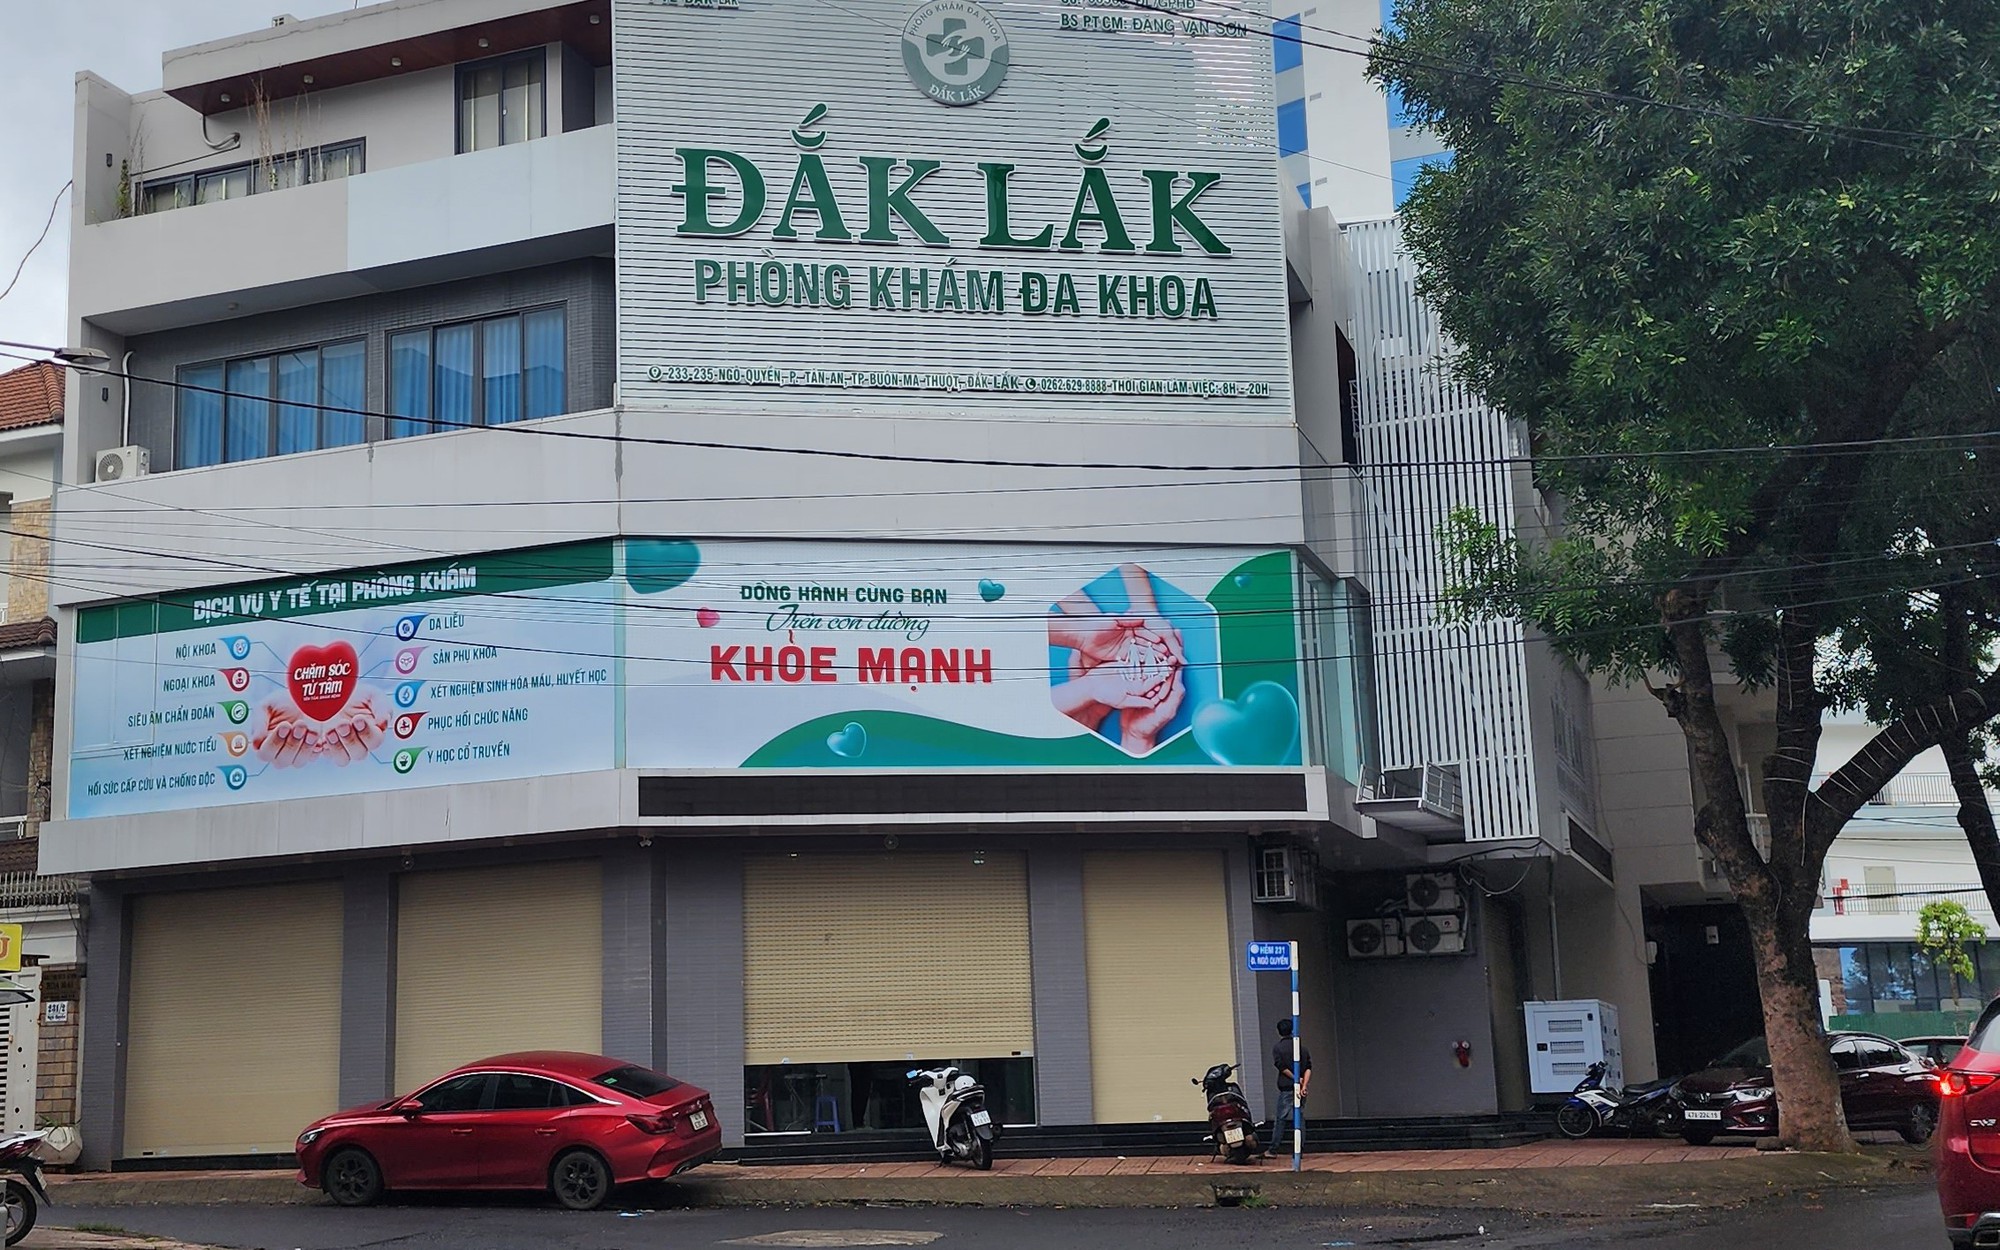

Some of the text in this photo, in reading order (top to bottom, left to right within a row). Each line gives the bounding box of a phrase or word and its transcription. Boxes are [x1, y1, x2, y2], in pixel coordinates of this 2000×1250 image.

[981, 16, 1001, 41] KHOA
[1061, 13, 1078, 27] BS
[670, 103, 1233, 256] ĐẮK LẮK
[694, 248, 1218, 319] PHÒNG KHÁM ĐA KHOA
[903, 374, 920, 387] MA
[1139, 380, 1163, 393] GIAN
[1222, 382, 1236, 395] 8H
[1248, 382, 1268, 395] 20H
[193, 562, 477, 623] DỊCH VỤ Y TẾ TẠI PHÒNG KHÁM
[739, 580, 947, 606] ĐỒNG HÀNH CÙNG BẠN
[429, 618, 442, 631] DA
[828, 616, 862, 631] con
[176, 643, 217, 661] NỘI KHOA
[433, 649, 450, 664] SẢN
[453, 649, 470, 663] PHỤ
[710, 629, 992, 692] KHỎE MẠNH
[294, 659, 352, 680] CHĂM SÓC
[163, 674, 216, 693] NGOẠI KHOA
[318, 677, 343, 695] TÂM
[431, 668, 607, 699] XÉT NGHIỆM SINH HÓA MÁU, HUYẾT HỌC
[428, 715, 453, 731] PHỤC
[474, 709, 499, 725] CHỨC
[502, 706, 529, 723] NĂNG
[427, 750, 434, 763] Y
[436, 748, 455, 765] HỌC
[457, 741, 471, 761] CỔ
[156, 775, 167, 790] VÀ
